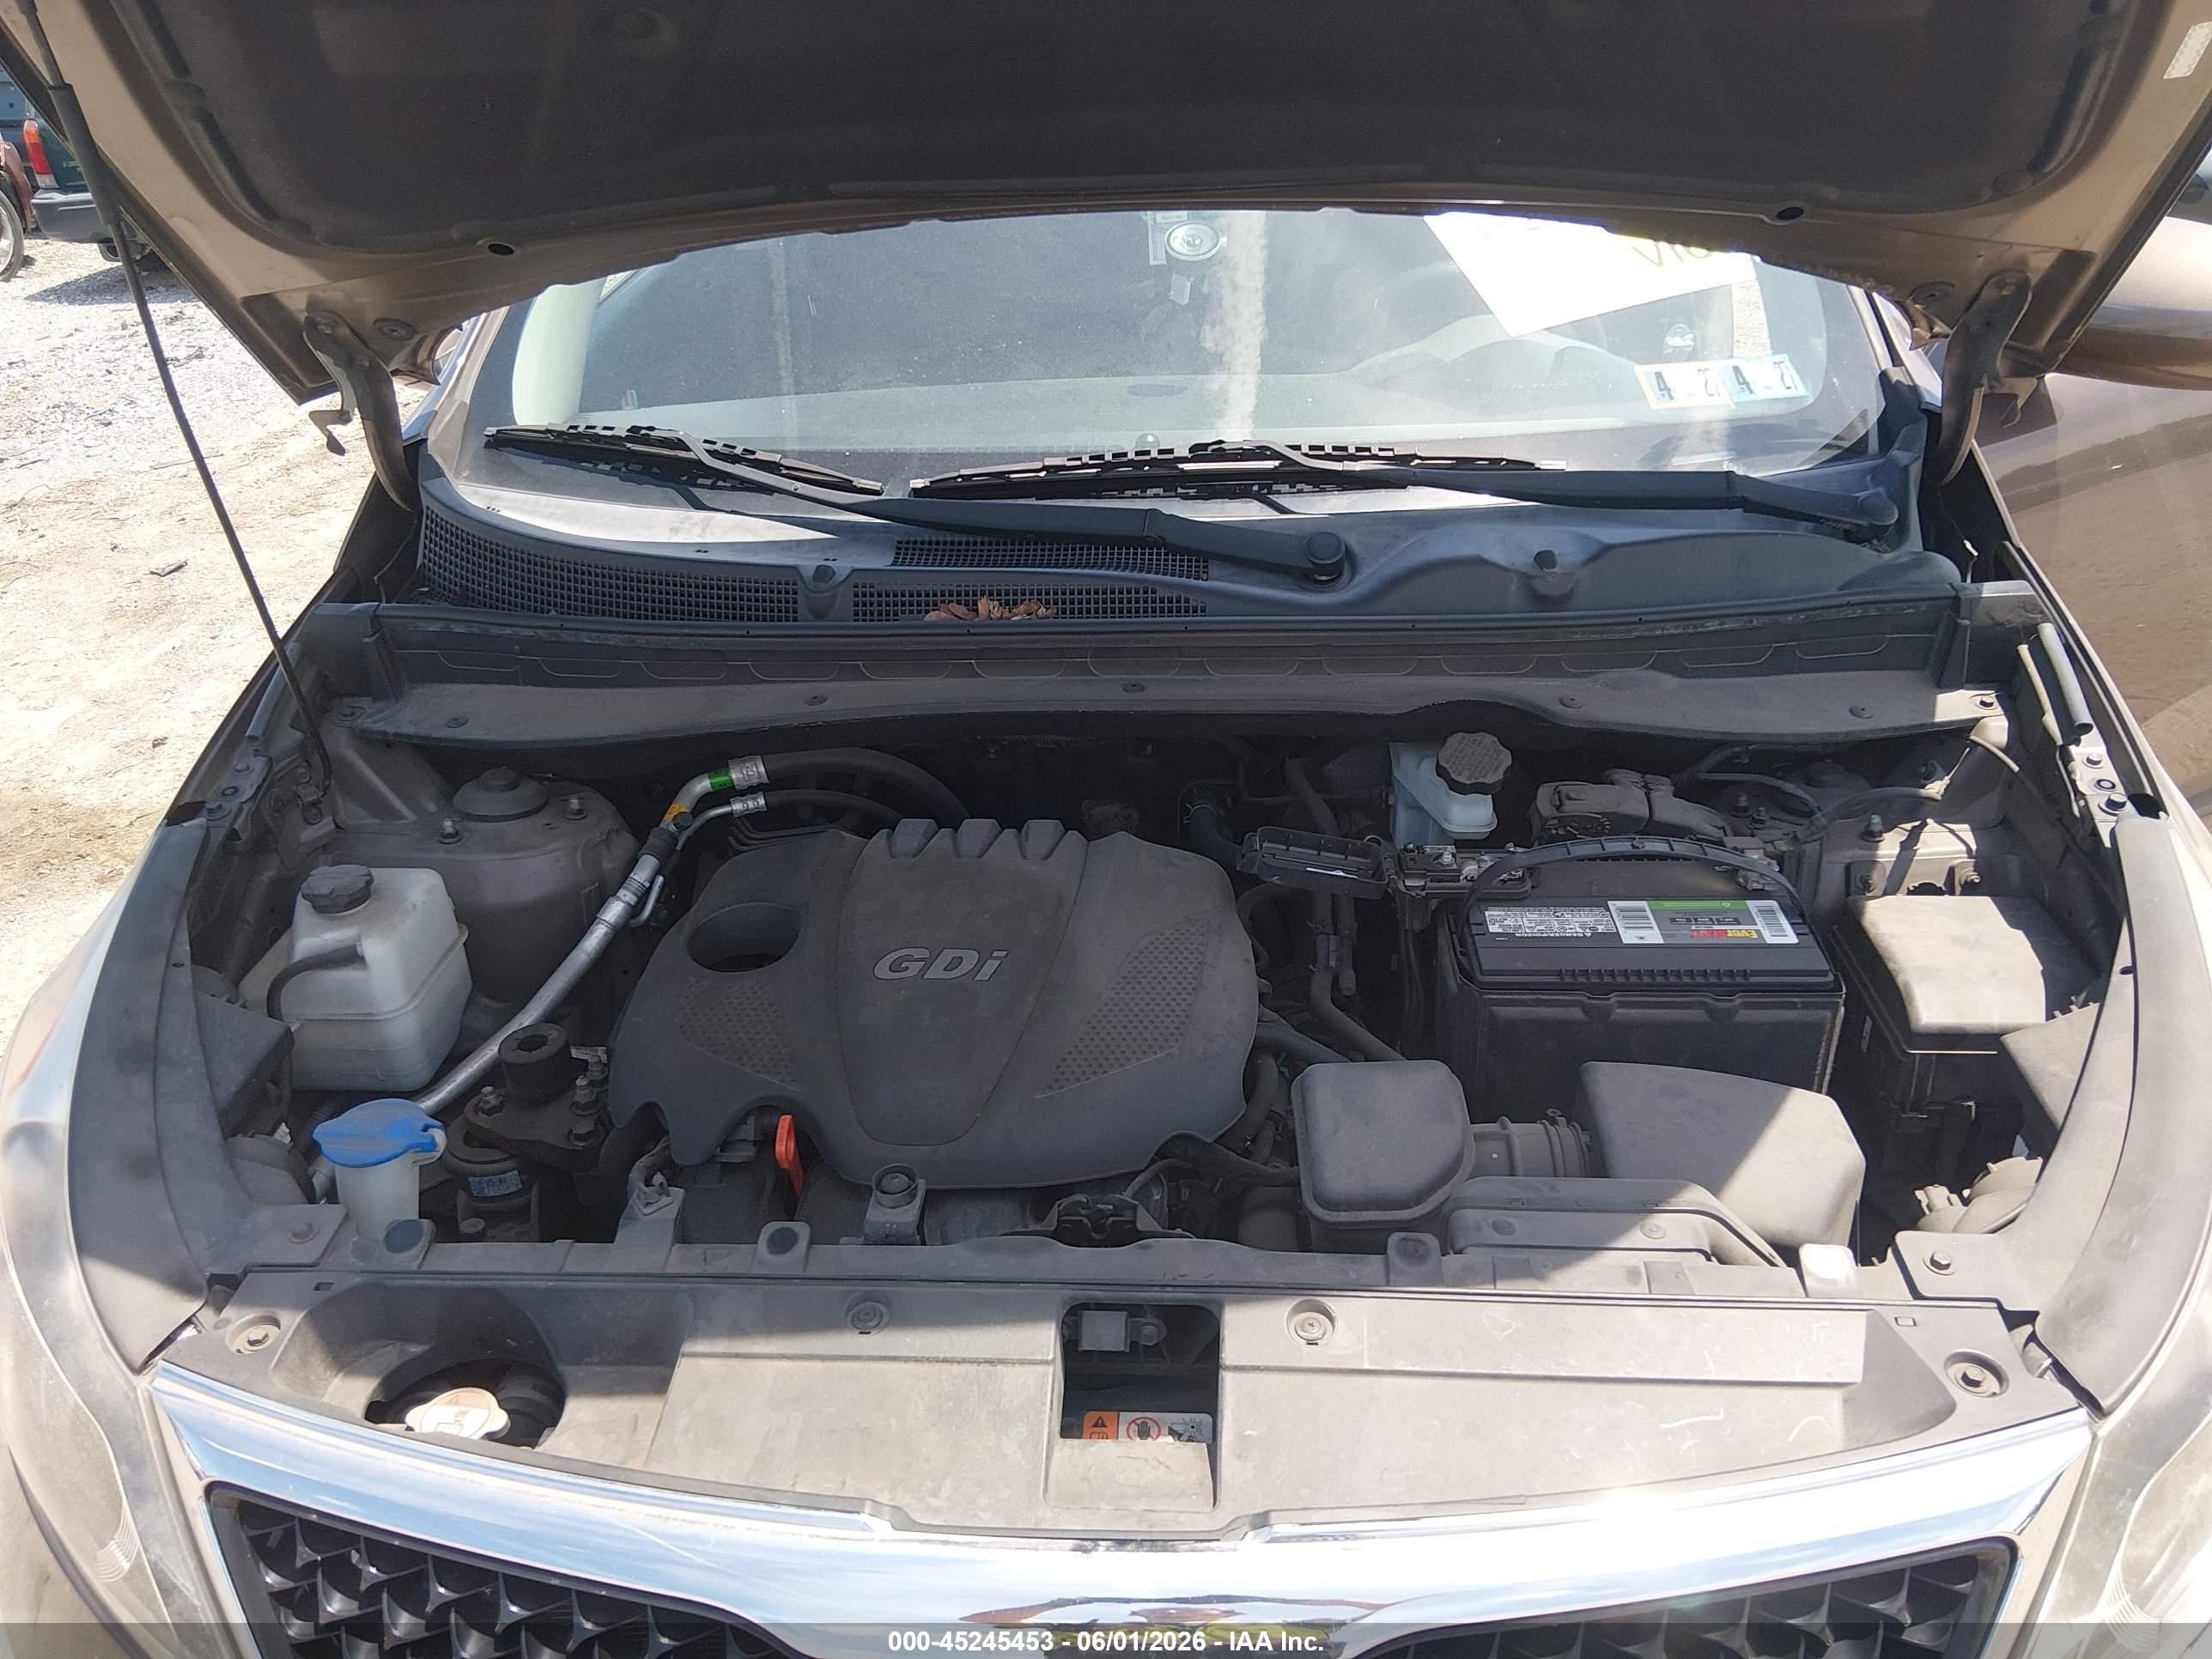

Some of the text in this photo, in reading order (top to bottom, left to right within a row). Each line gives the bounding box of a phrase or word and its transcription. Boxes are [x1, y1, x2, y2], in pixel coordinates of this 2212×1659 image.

[1654, 371, 1675, 401] 4
[1731, 364, 1754, 395] 4
[872, 946, 1010, 981] GDi
